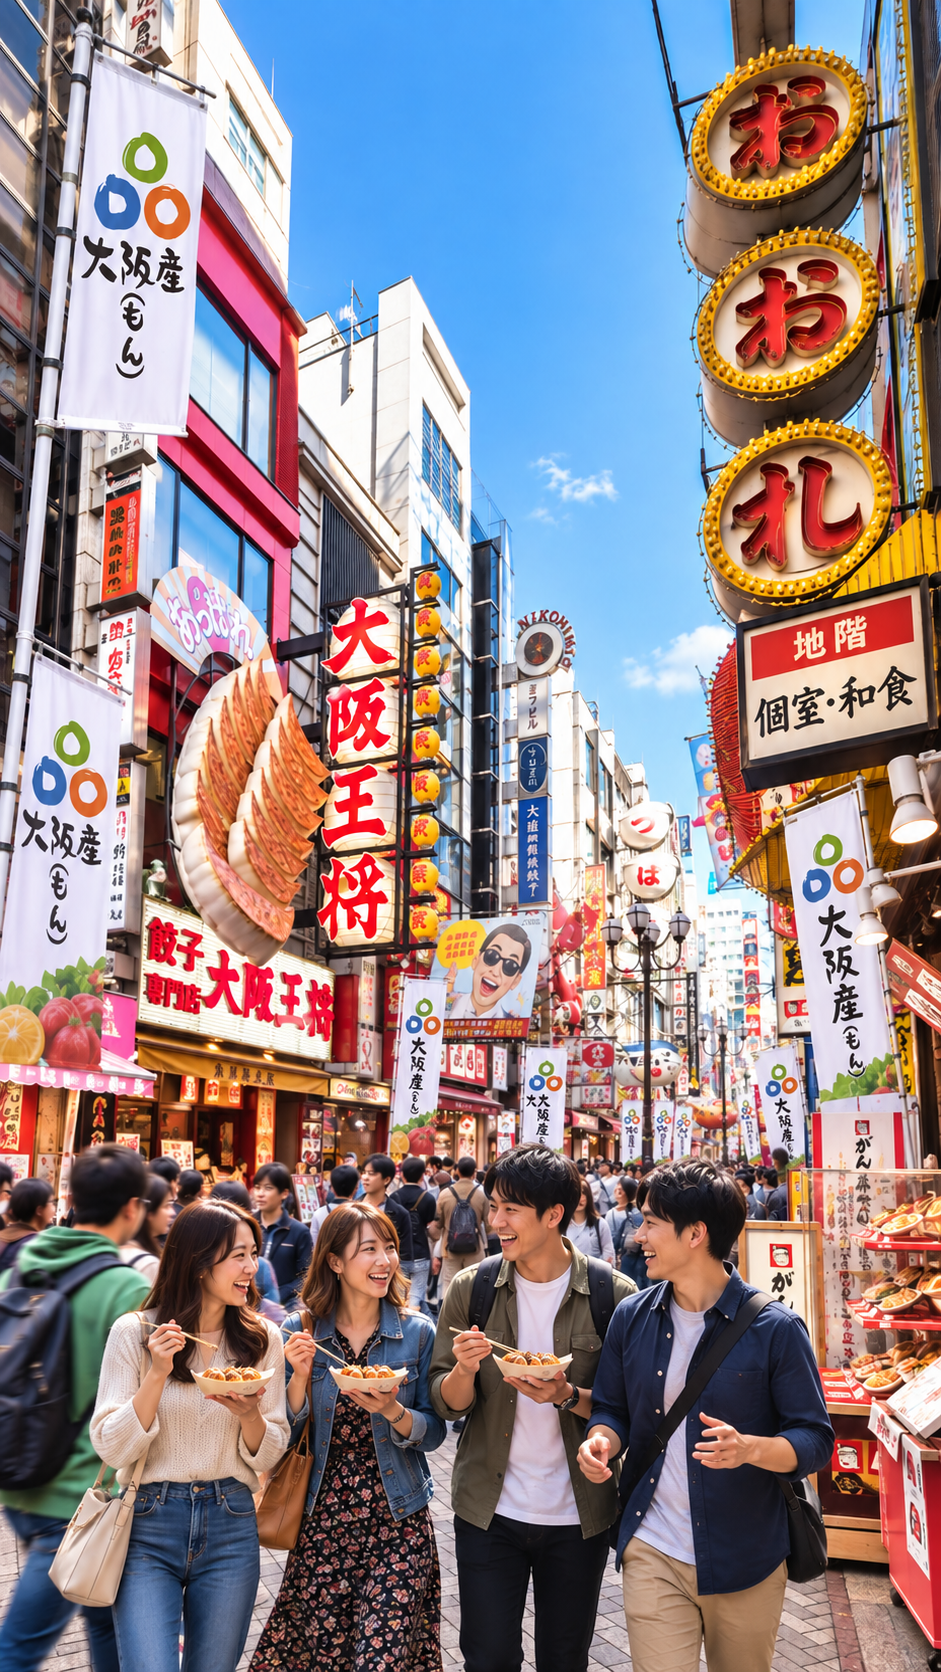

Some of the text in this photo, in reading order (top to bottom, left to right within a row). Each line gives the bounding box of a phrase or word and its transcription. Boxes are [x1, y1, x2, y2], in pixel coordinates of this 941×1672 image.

[81, 235, 185, 294] 大阪産
[115, 292, 145, 379] (もん)
[793, 615, 868, 661] 地階
[316, 597, 397, 943] 大阪王将
[22, 808, 102, 866] 大阪産
[45, 863, 69, 945] (もん)
[146, 916, 204, 972] 餃子
[203, 949, 335, 1042] 大阪王将
